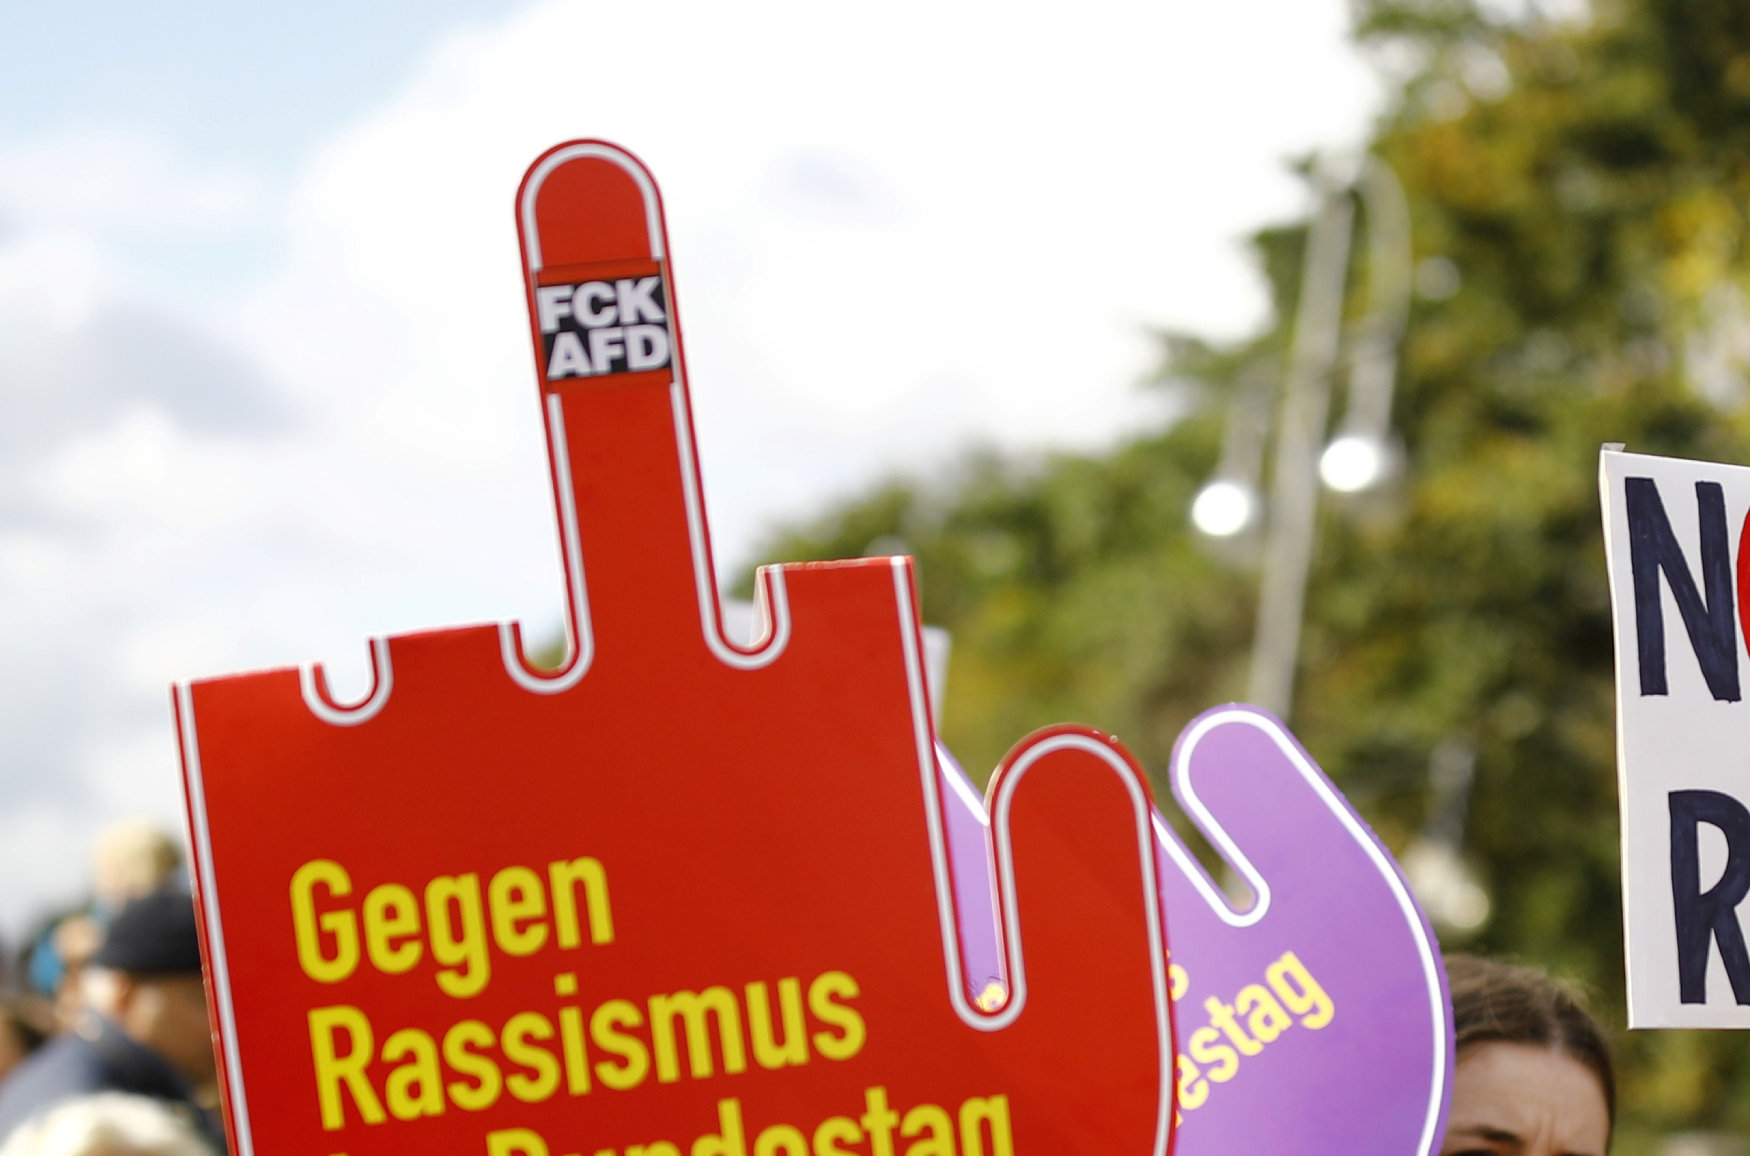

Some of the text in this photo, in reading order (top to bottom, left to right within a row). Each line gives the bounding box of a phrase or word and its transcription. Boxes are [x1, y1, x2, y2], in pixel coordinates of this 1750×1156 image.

[536, 276, 666, 334] FCK
[547, 324, 670, 380] AFD
[289, 856, 614, 997] Gegen
[307, 970, 866, 1130] Rassismus
[1175, 950, 1336, 1128] estag
